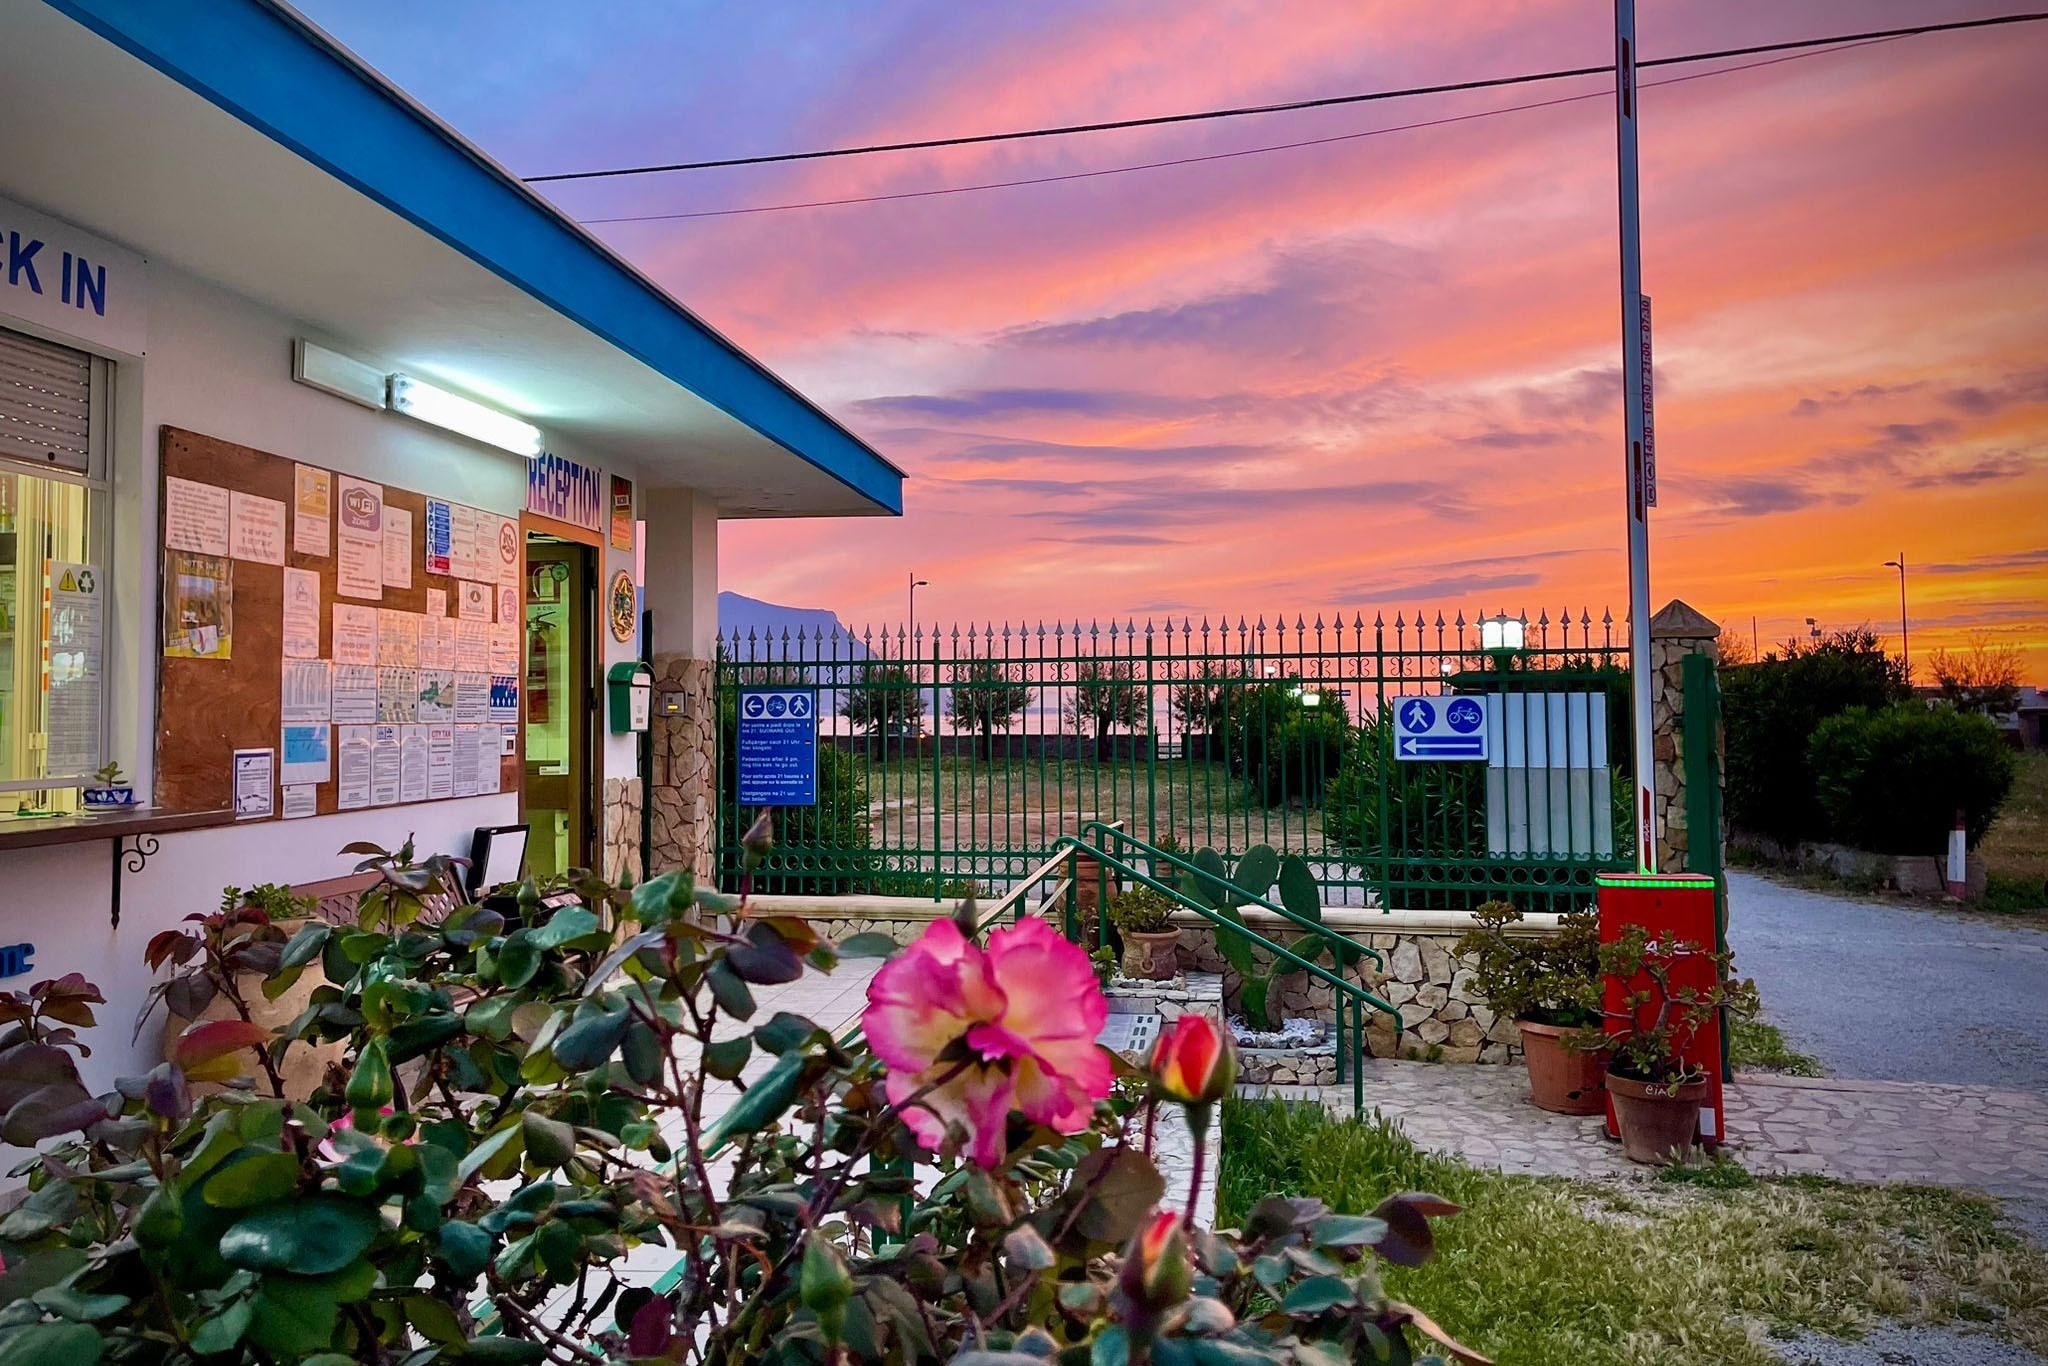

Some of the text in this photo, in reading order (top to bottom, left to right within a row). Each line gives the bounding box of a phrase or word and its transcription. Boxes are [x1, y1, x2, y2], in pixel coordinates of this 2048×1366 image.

[0, 231, 106, 317] K IN
[1641, 300, 1650, 332] 07:30
[1642, 342, 1651, 374] 21:00
[1644, 426, 1653, 457] 14:30
[528, 451, 601, 526] RECEPTION
[351, 516, 371, 528] ZONE
